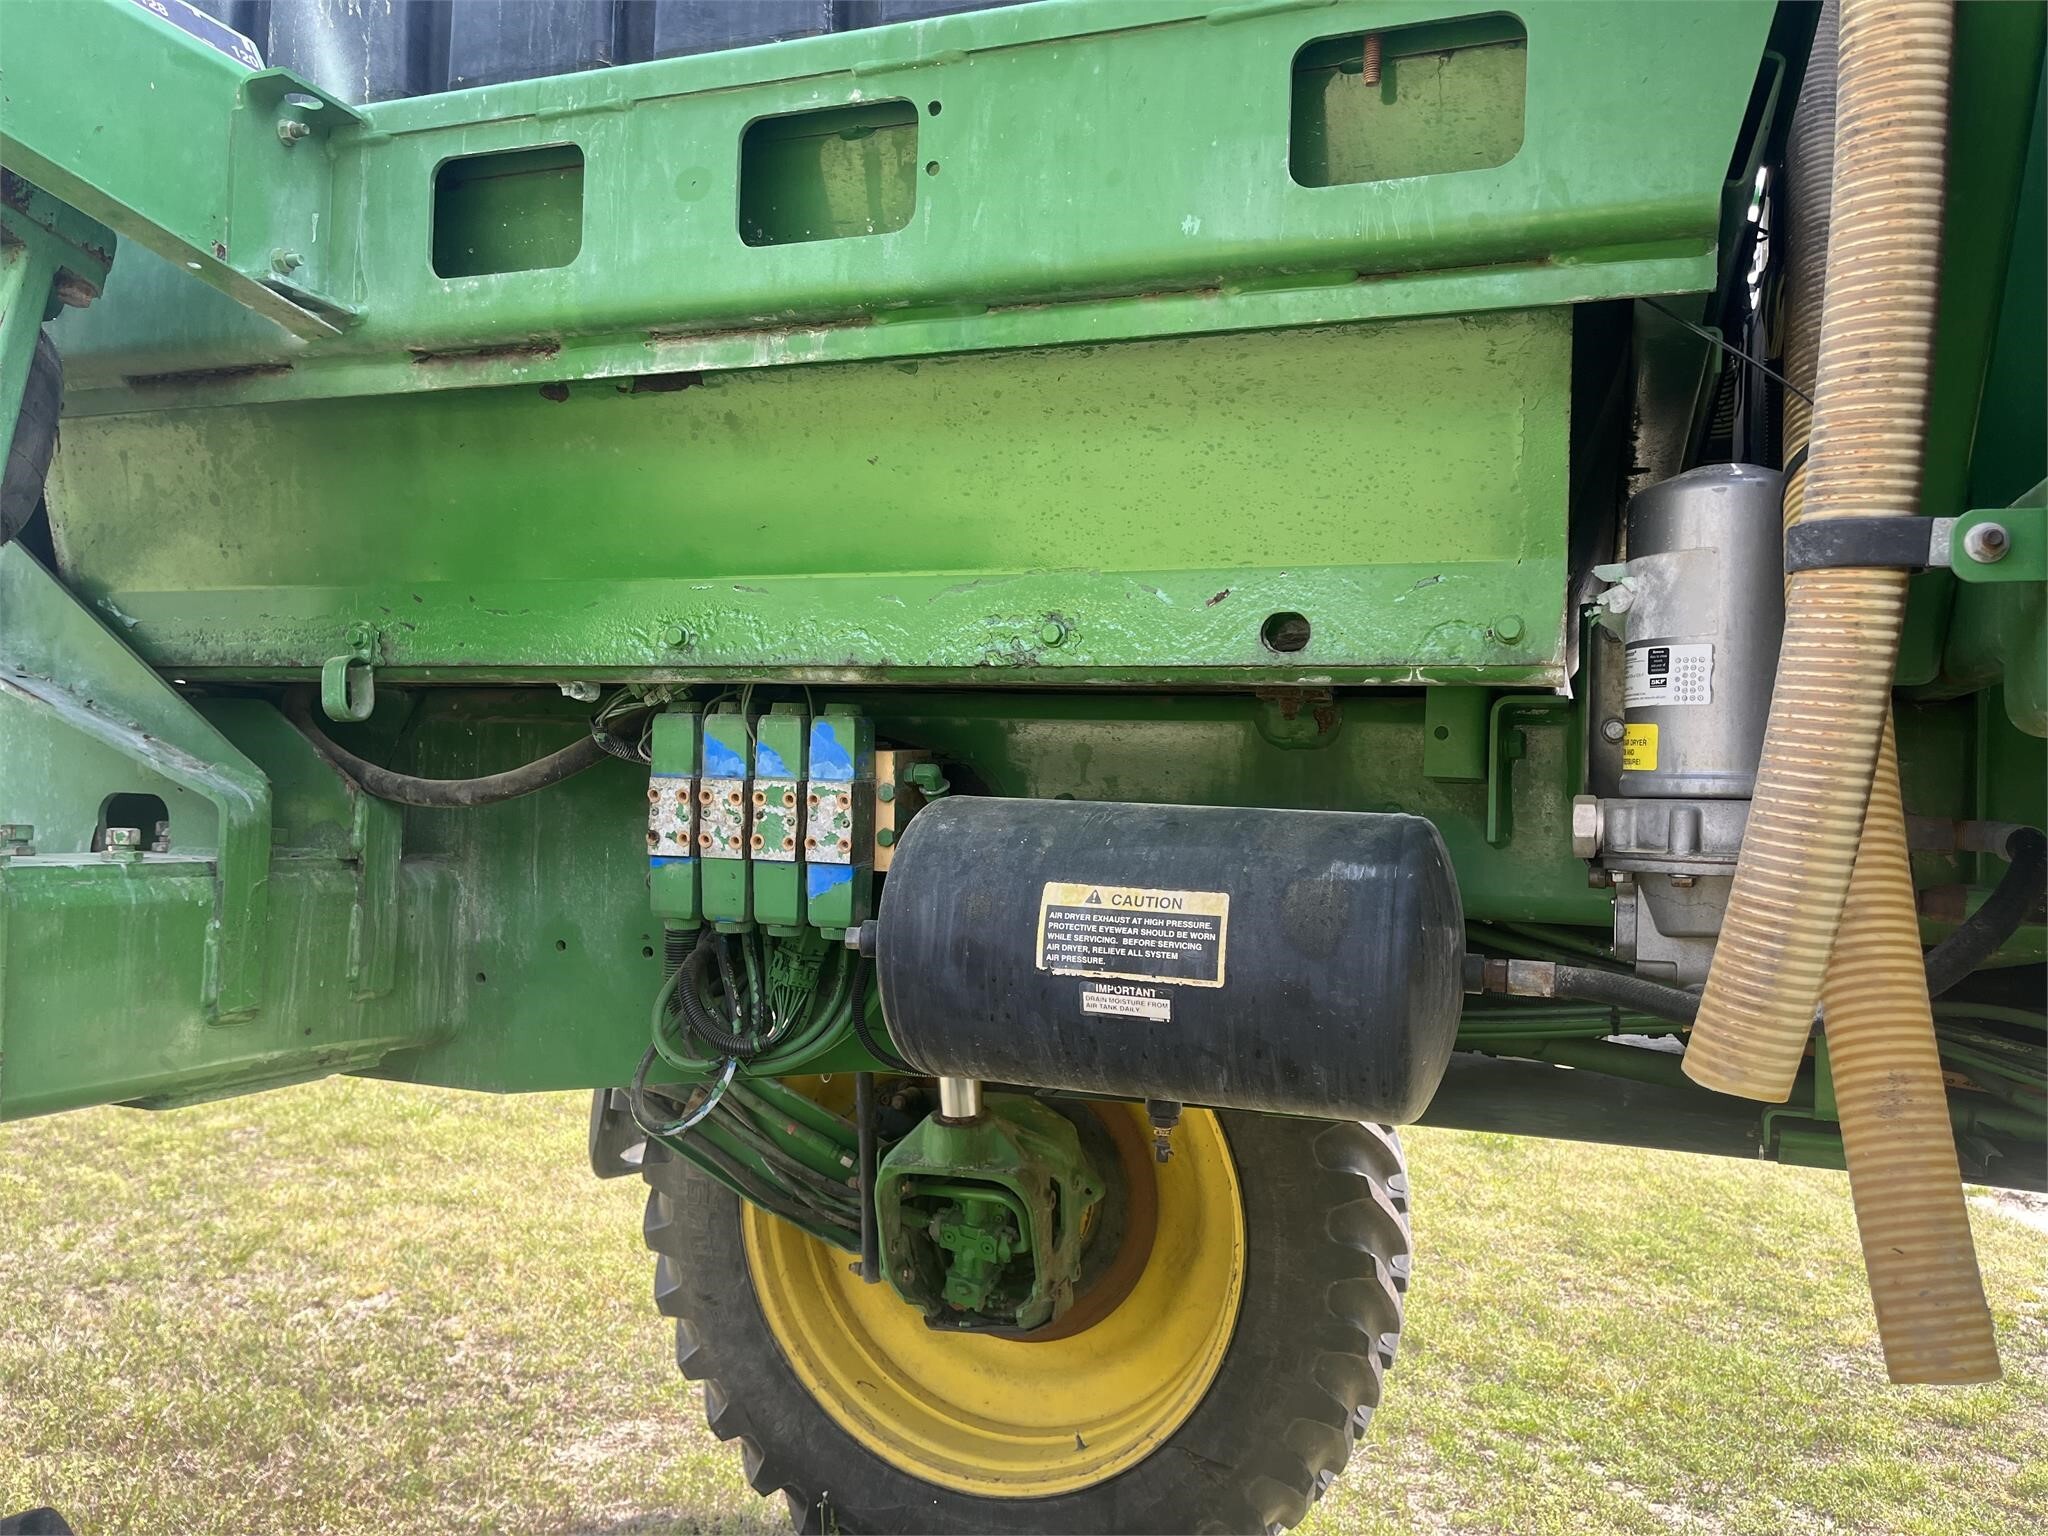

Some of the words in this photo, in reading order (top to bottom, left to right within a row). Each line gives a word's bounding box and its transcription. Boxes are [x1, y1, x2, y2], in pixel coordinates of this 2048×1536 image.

[231, 46, 258, 68] 120
[1111, 894, 1183, 910] CAUTION
[1064, 913, 1091, 922] DRYER
[1093, 915, 1130, 924] EXHAUST
[1144, 918, 1164, 926] HIGH
[1166, 919, 1212, 930] PRESSURE.
[1048, 922, 1096, 932] PROTECTIVE
[1099, 925, 1139, 935] EYEWEAR
[1140, 928, 1174, 938] SHOULD
[1190, 932, 1216, 941] WORN
[1047, 933, 1072, 941] WHILE
[1074, 934, 1118, 944] SERVICING.
[1123, 938, 1156, 947] BEFORE
[1158, 940, 1202, 950] SERVICING
[1061, 955, 1106, 965] PRESSURE.
[1062, 945, 1090, 954] DRYER,
[1092, 946, 1126, 955] RELIEVE
[1128, 949, 1143, 957] ALL
[1145, 950, 1178, 960] SYSTEM
[1096, 984, 1156, 998] IMPORTANT
[1109, 998, 1145, 1006] MOISTURE
